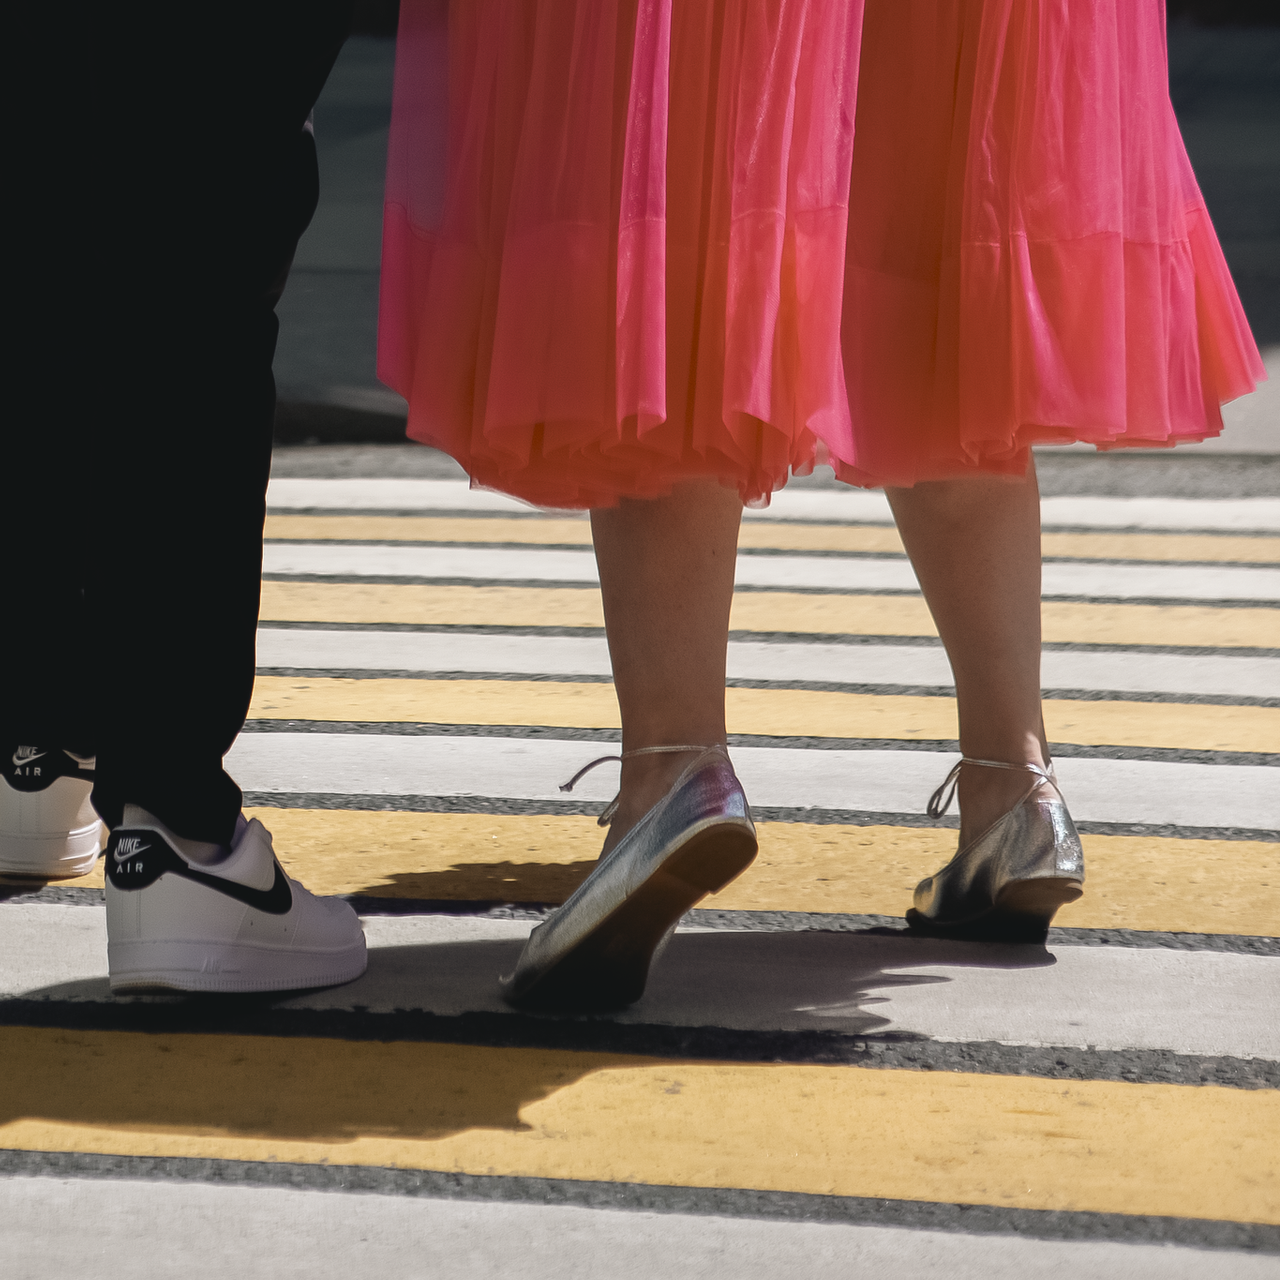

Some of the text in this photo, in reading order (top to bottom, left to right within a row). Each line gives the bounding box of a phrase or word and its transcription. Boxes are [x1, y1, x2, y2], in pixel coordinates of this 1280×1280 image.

[14, 767, 41, 776] AIR
[117, 838, 141, 853] NIKE
[116, 862, 143, 873] AIR
